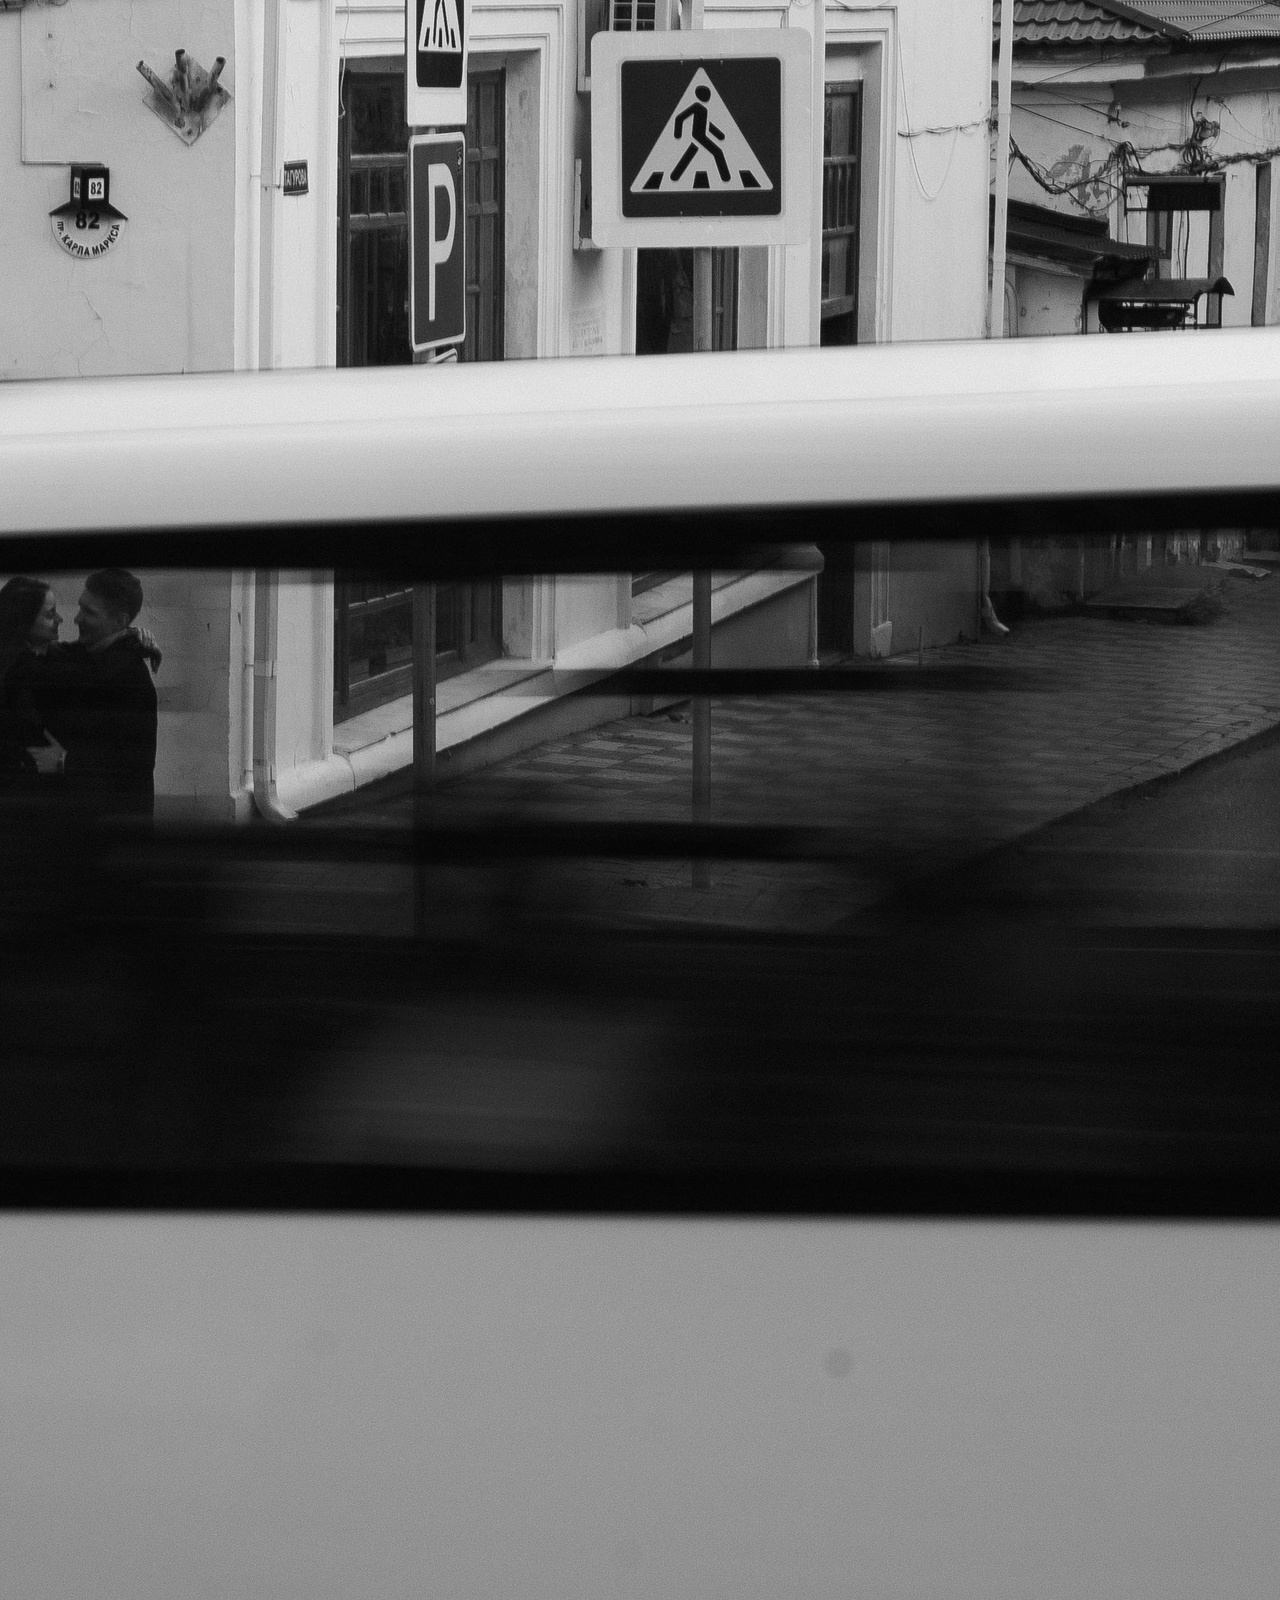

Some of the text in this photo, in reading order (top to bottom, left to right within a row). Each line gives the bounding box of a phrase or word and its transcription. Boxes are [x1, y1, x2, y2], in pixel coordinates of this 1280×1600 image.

[284, 169, 307, 186] ТАГУРОВА
[91, 182, 102, 195] 82
[76, 211, 100, 229] 82
[62, 234, 90, 256] КАРЛА
[92, 224, 120, 256] МАРКСА
[428, 163, 456, 321] P
